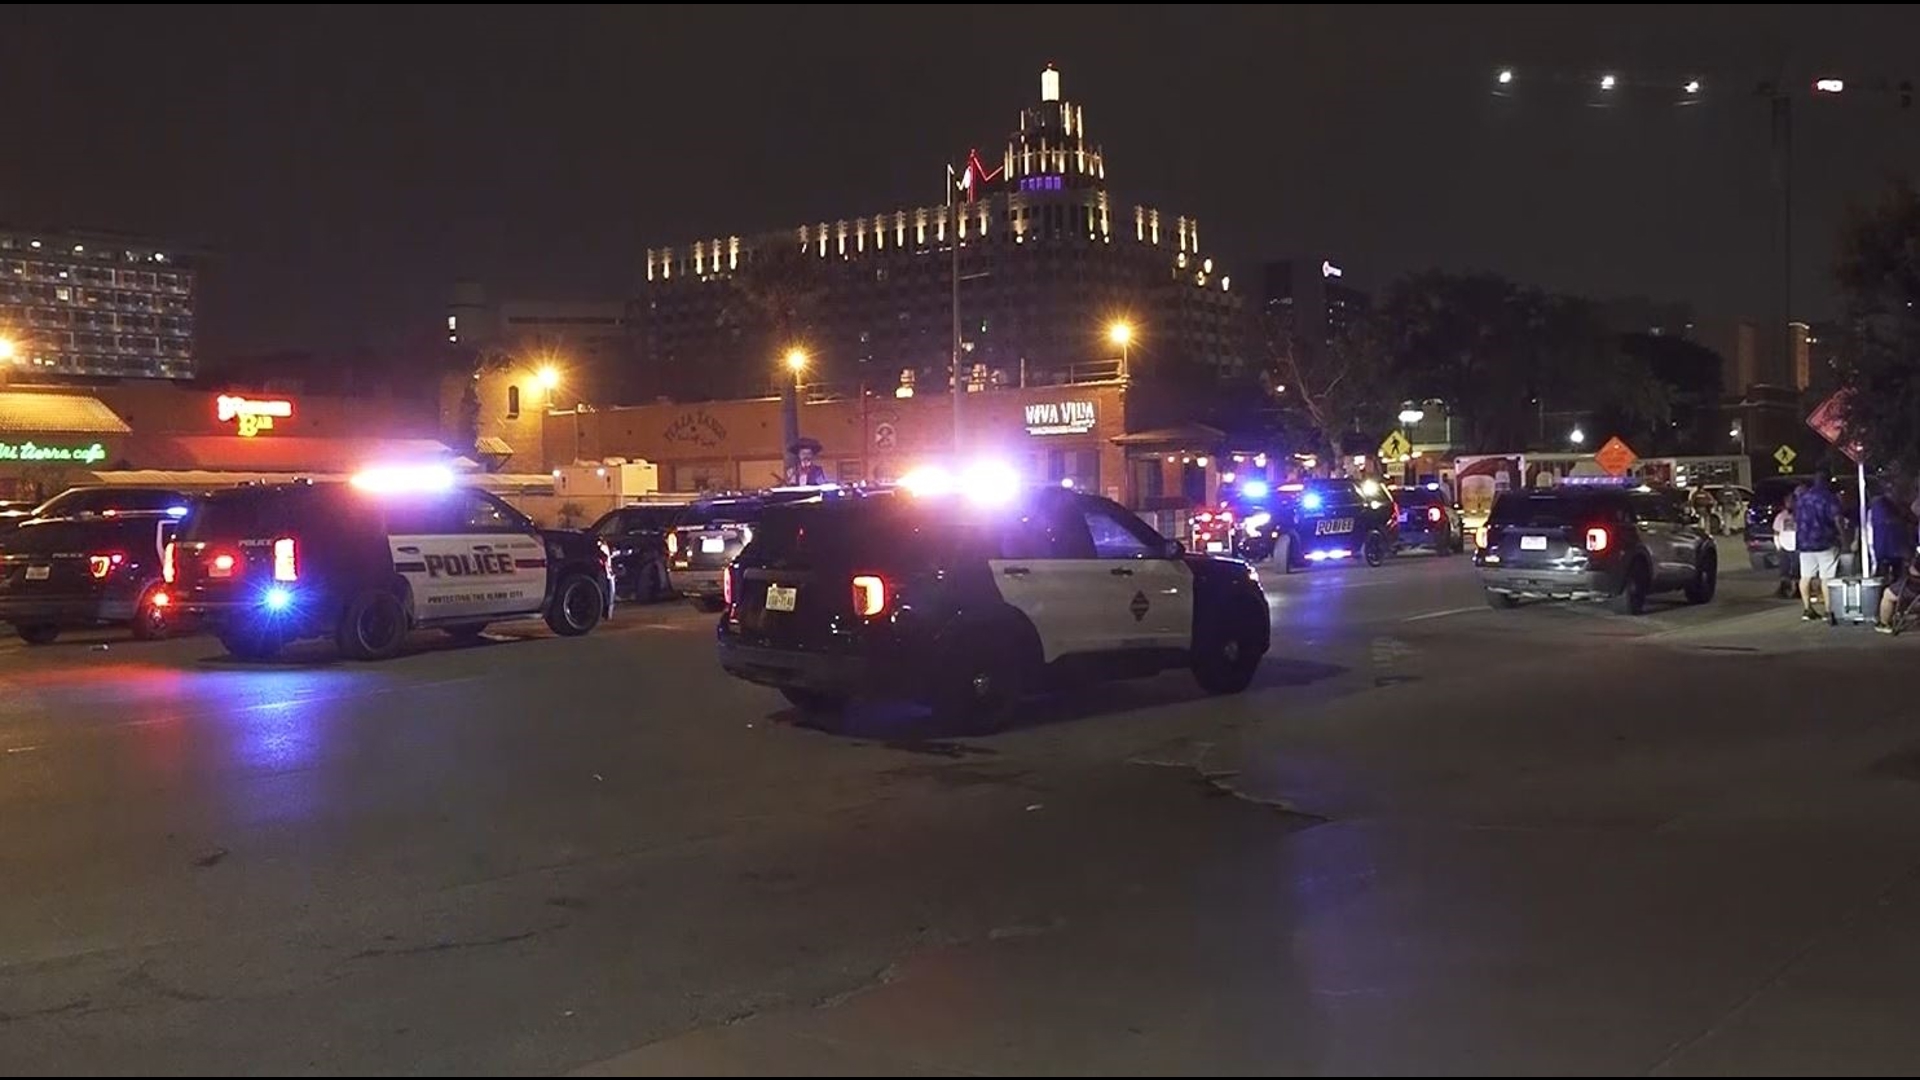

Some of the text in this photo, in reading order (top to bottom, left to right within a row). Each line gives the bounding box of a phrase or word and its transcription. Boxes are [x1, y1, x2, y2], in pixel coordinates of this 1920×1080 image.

[1025, 404, 1059, 424] VIVA
[1317, 519, 1353, 534] POLICE
[424, 553, 515, 578] POLICE
[472, 593, 485, 601] THE
